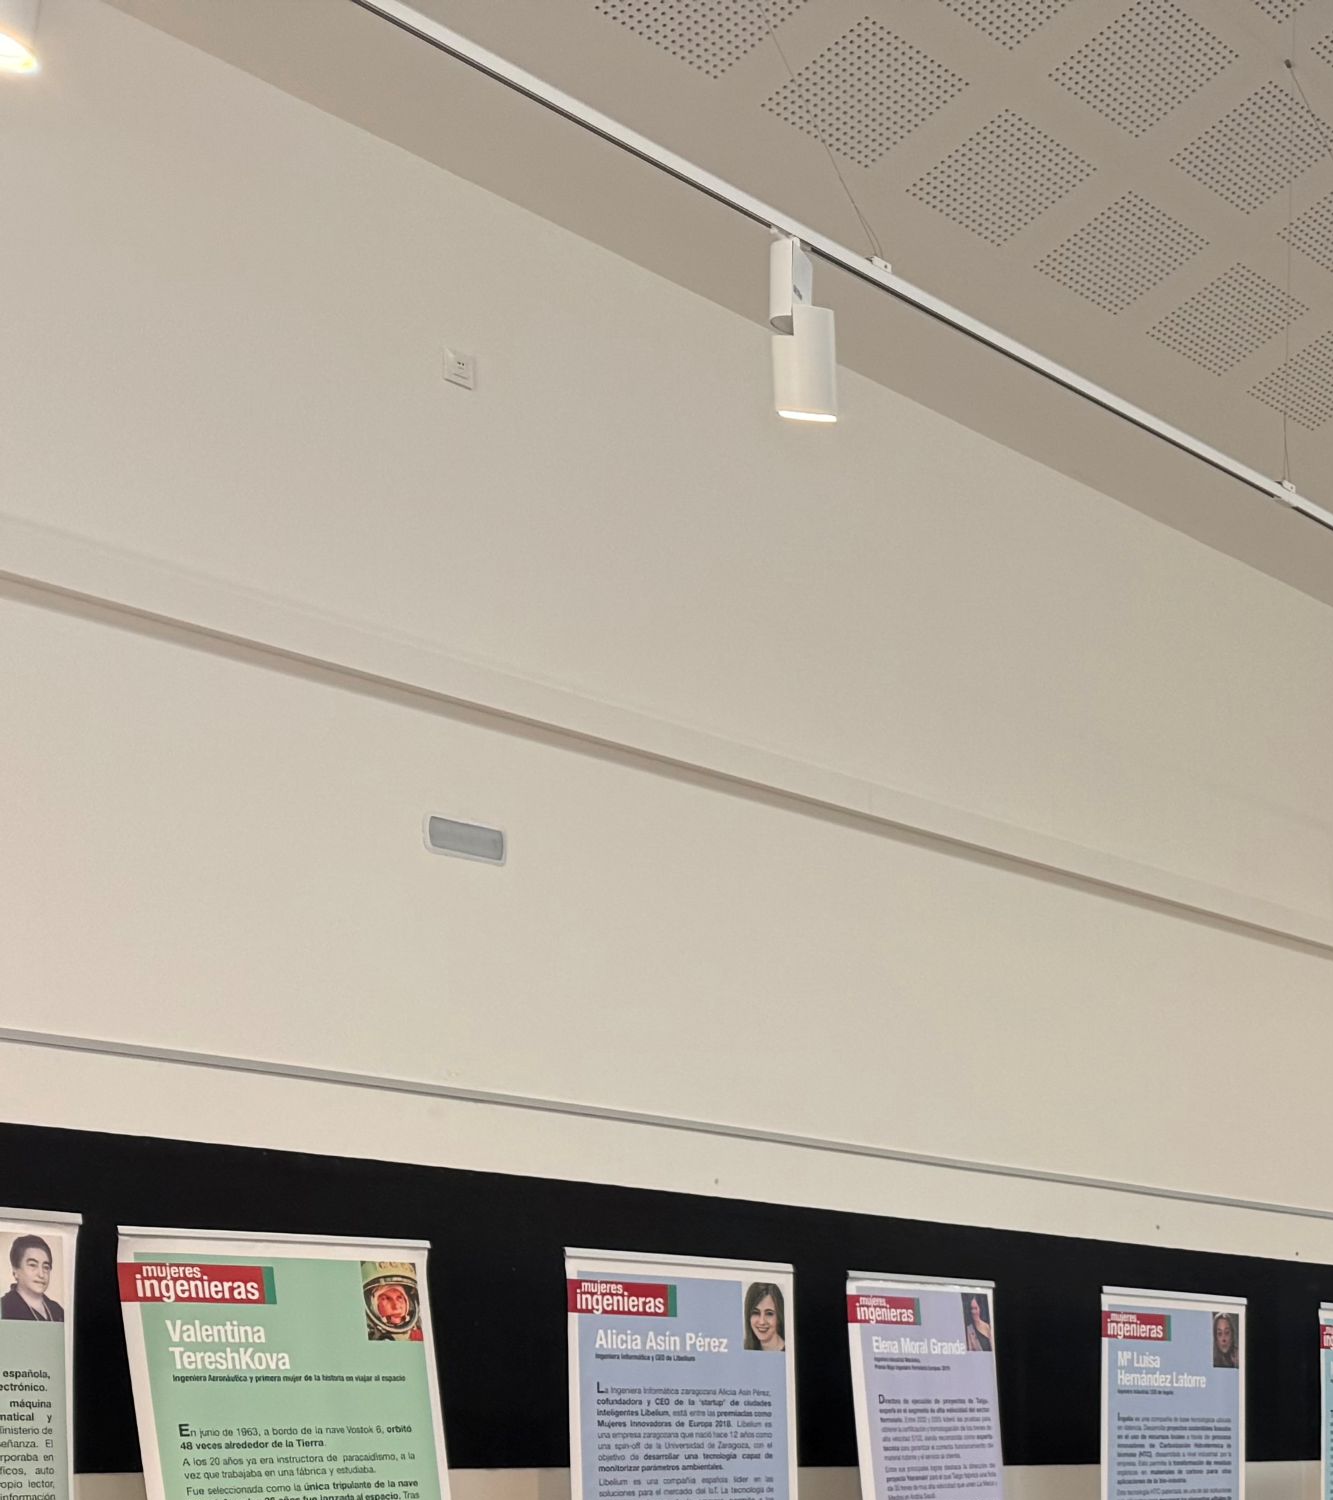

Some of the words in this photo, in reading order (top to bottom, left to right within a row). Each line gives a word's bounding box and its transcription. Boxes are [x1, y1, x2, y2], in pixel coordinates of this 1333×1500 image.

[142, 1263, 201, 1279] mujeres
[136, 1274, 260, 1302] ingenieras
[581, 1282, 623, 1294] mujeres
[576, 1290, 664, 1314] ingenieras
[860, 1296, 888, 1307] mujeres
[856, 1304, 914, 1324] ingenieras
[1110, 1312, 1138, 1322] mujeres
[165, 1320, 265, 1343] Valentina
[1107, 1319, 1163, 1339] ingenieras
[595, 1330, 641, 1350] Alicia
[646, 1331, 680, 1350] Asín
[686, 1332, 728, 1352] Pérez
[872, 1336, 898, 1354] Elena
[900, 1337, 928, 1354] Moral
[930, 1339, 967, 1355] Grande
[169, 1347, 290, 1370] TereshKova
[1134, 1352, 1160, 1369] Luisa
[3, 1370, 50, 1381] española,
[173, 1375, 206, 1383] Ingeniera
[208, 1374, 247, 1382] Aeronáutica
[255, 1375, 281, 1383] primera
[283, 1375, 302, 1383] mujer
[355, 1375, 372, 1383] viajar
[382, 1375, 405, 1383] espacio
[1117, 1370, 1171, 1387] Hernández
[1173, 1372, 1206, 1388] Latorre
[10, 1400, 51, 1410] máquina
[179, 1424, 196, 1438] En
[200, 1428, 220, 1438] junio
[223, 1428, 234, 1436] de
[237, 1427, 260, 1437] 1963,
[272, 1427, 297, 1435] bordo
[301, 1427, 311, 1435] de
[346, 1425, 373, 1434] Vostok
[376, 1425, 384, 1434] 6,
[387, 1425, 412, 1434] orbitó
[180, 1442, 192, 1450] 48
[225, 1440, 269, 1449] alrededor
[271, 1440, 283, 1448] de
[286, 1440, 294, 1448] la
[296, 1439, 327, 1448] Tierra.
[183, 1458, 190, 1466] A
[193, 1457, 206, 1466] los
[209, 1457, 220, 1465] 20
[223, 1456, 243, 1465] años
[246, 1457, 257, 1466] ya
[277, 1454, 323, 1463] instructora
[327, 1454, 337, 1462] de
[343, 1452, 398, 1463] paracaidismo,
[408, 1452, 415, 1460] la
[184, 1472, 201, 1480] vez
[204, 1471, 219, 1480] que
[222, 1468, 262, 1479] trabajaba
[265, 1469, 275, 1477] en
[297, 1466, 327, 1475] fábrica
[329, 1468, 334, 1476] y
[337, 1464, 376, 1474] estudiaba.
